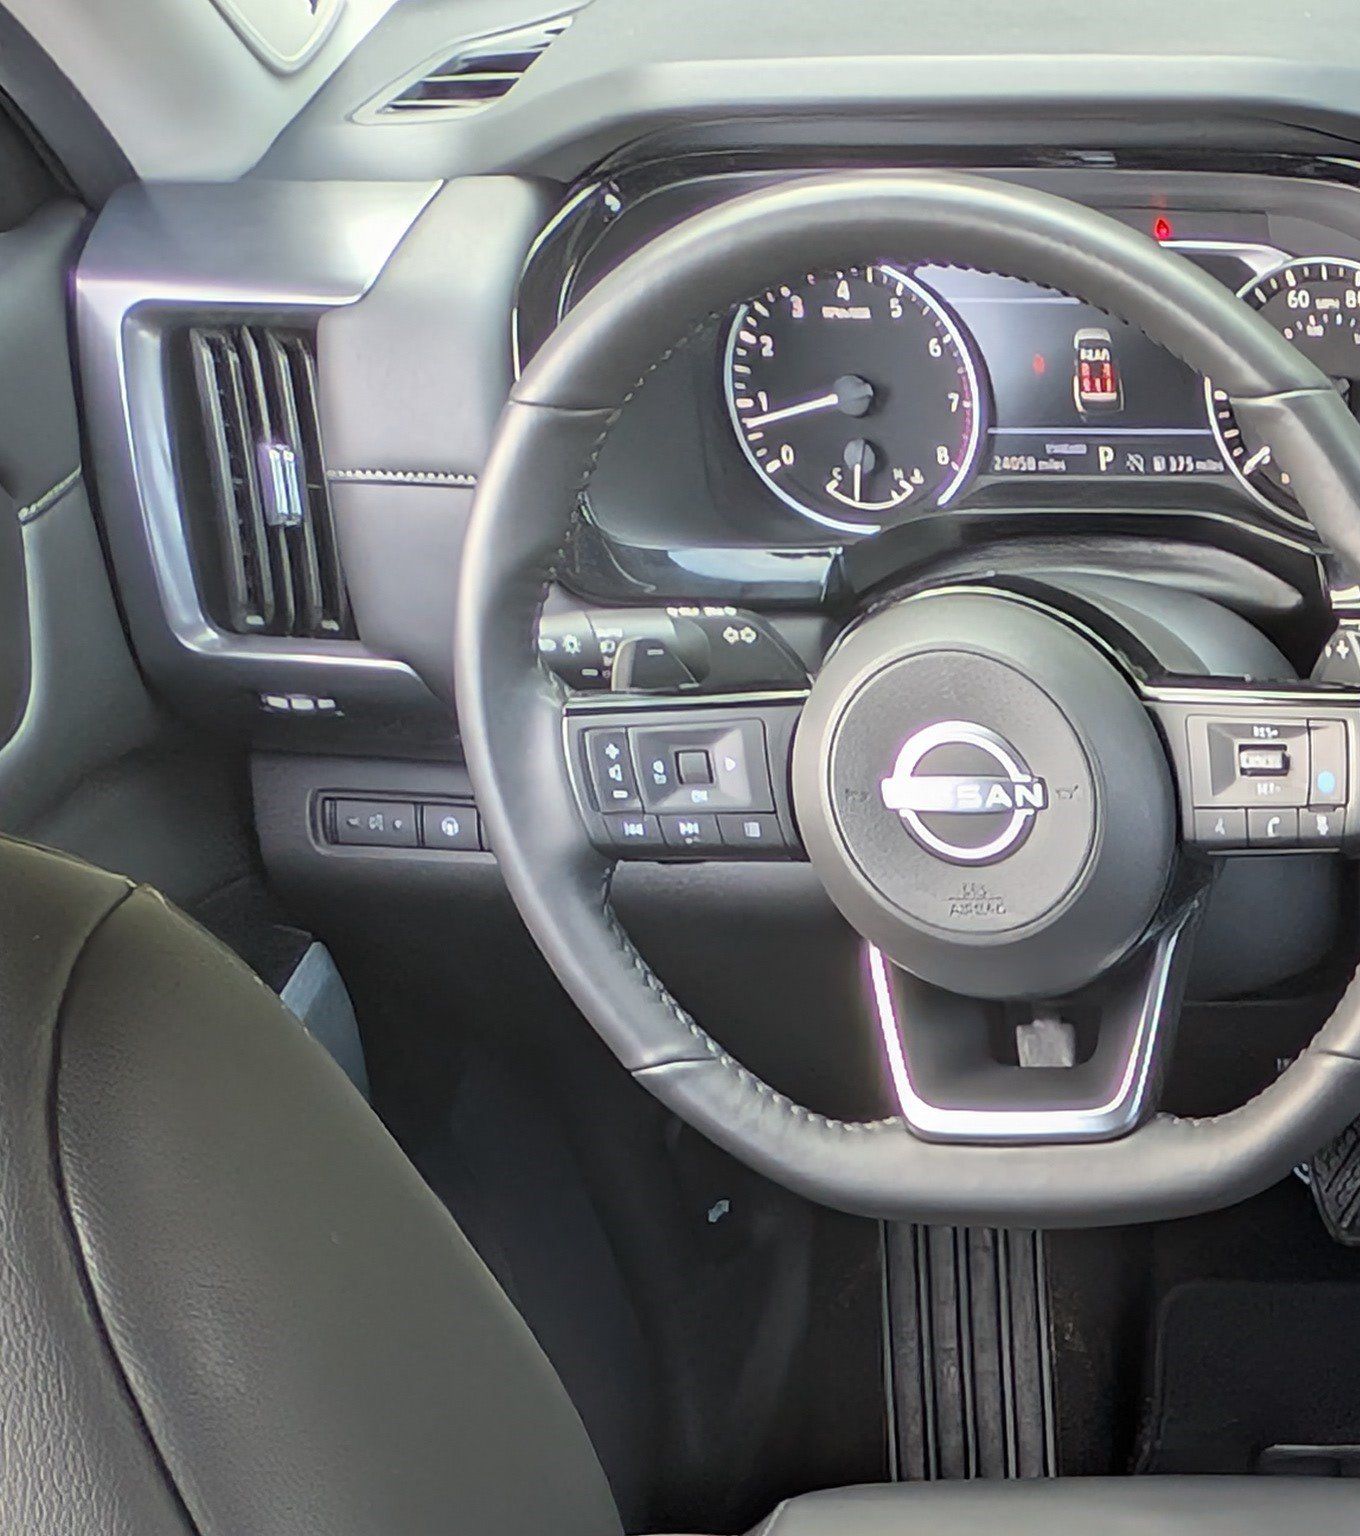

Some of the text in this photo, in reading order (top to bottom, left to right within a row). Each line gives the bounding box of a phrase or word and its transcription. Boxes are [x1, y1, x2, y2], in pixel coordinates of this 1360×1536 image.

[837, 280, 850, 301] 4
[1287, 290, 1310, 308] 60
[791, 295, 804, 319] 3
[890, 298, 902, 318] 5
[760, 335, 774, 357] 2
[929, 338, 942, 357] 6
[757, 391, 768, 412] 1
[948, 392, 959, 412] 7
[781, 444, 794, 465] 0
[937, 445, 949, 465] 8
[1099, 446, 1114, 471] P
